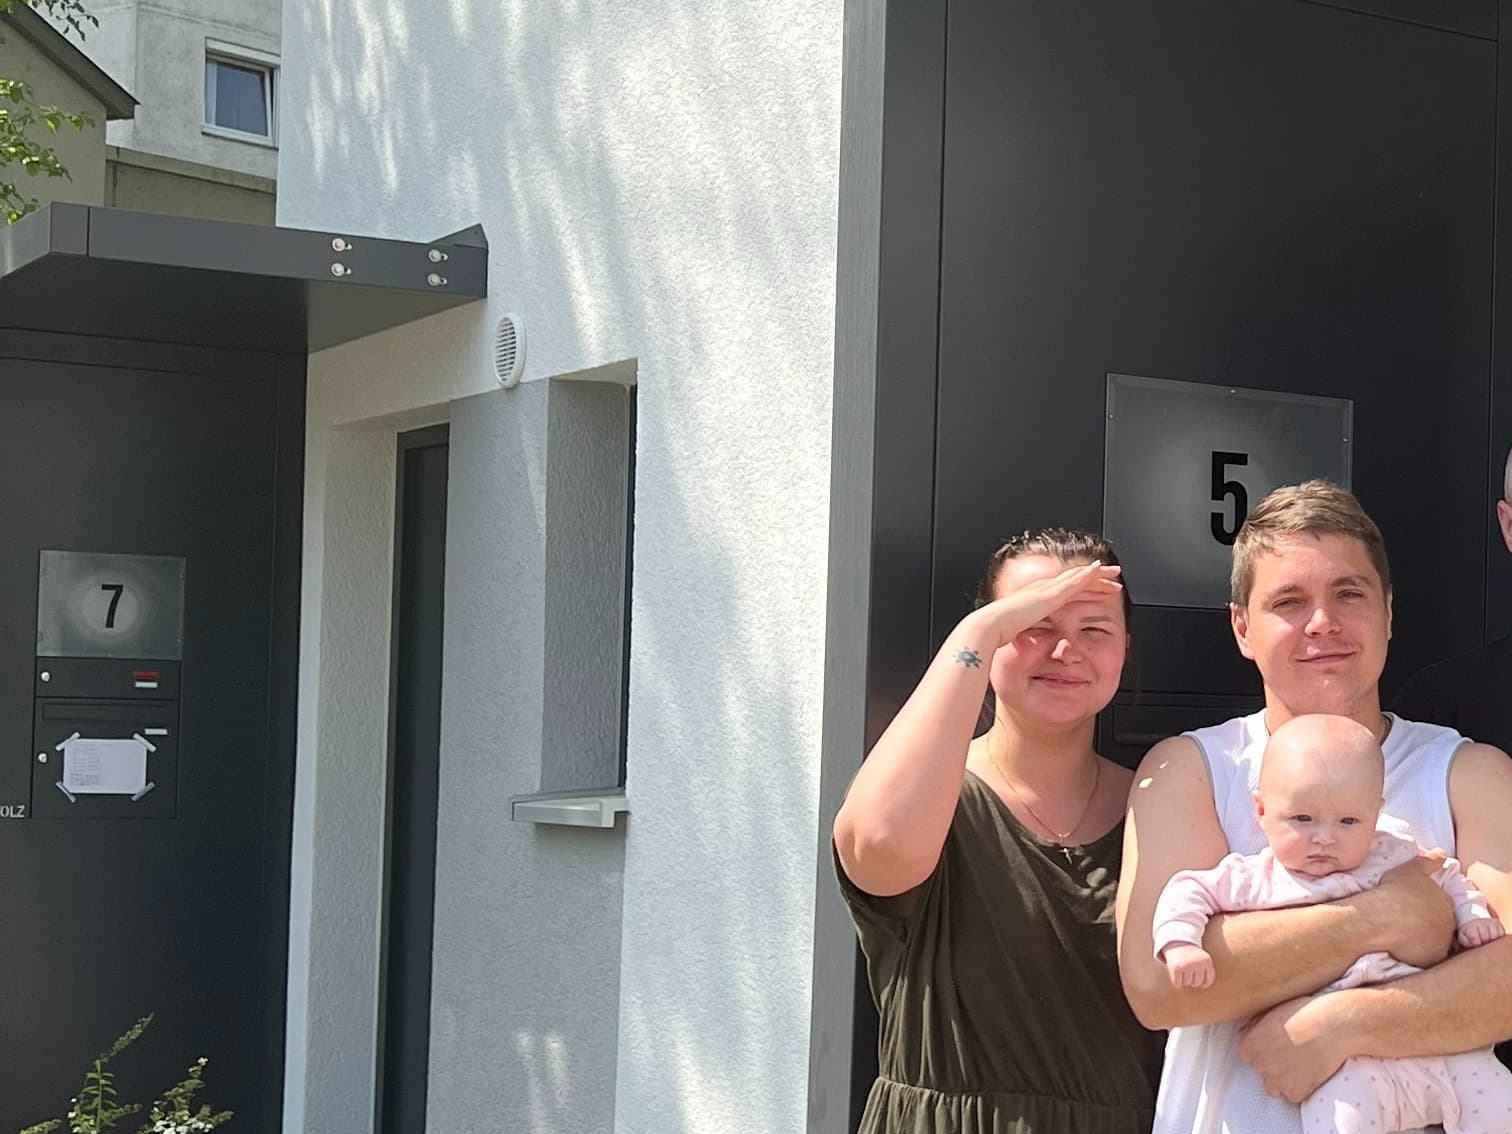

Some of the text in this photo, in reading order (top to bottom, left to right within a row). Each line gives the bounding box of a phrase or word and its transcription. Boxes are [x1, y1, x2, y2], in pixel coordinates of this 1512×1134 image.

[1211, 451, 1248, 545] 5
[101, 584, 124, 628] 7
[0, 805, 25, 818] OLZ
